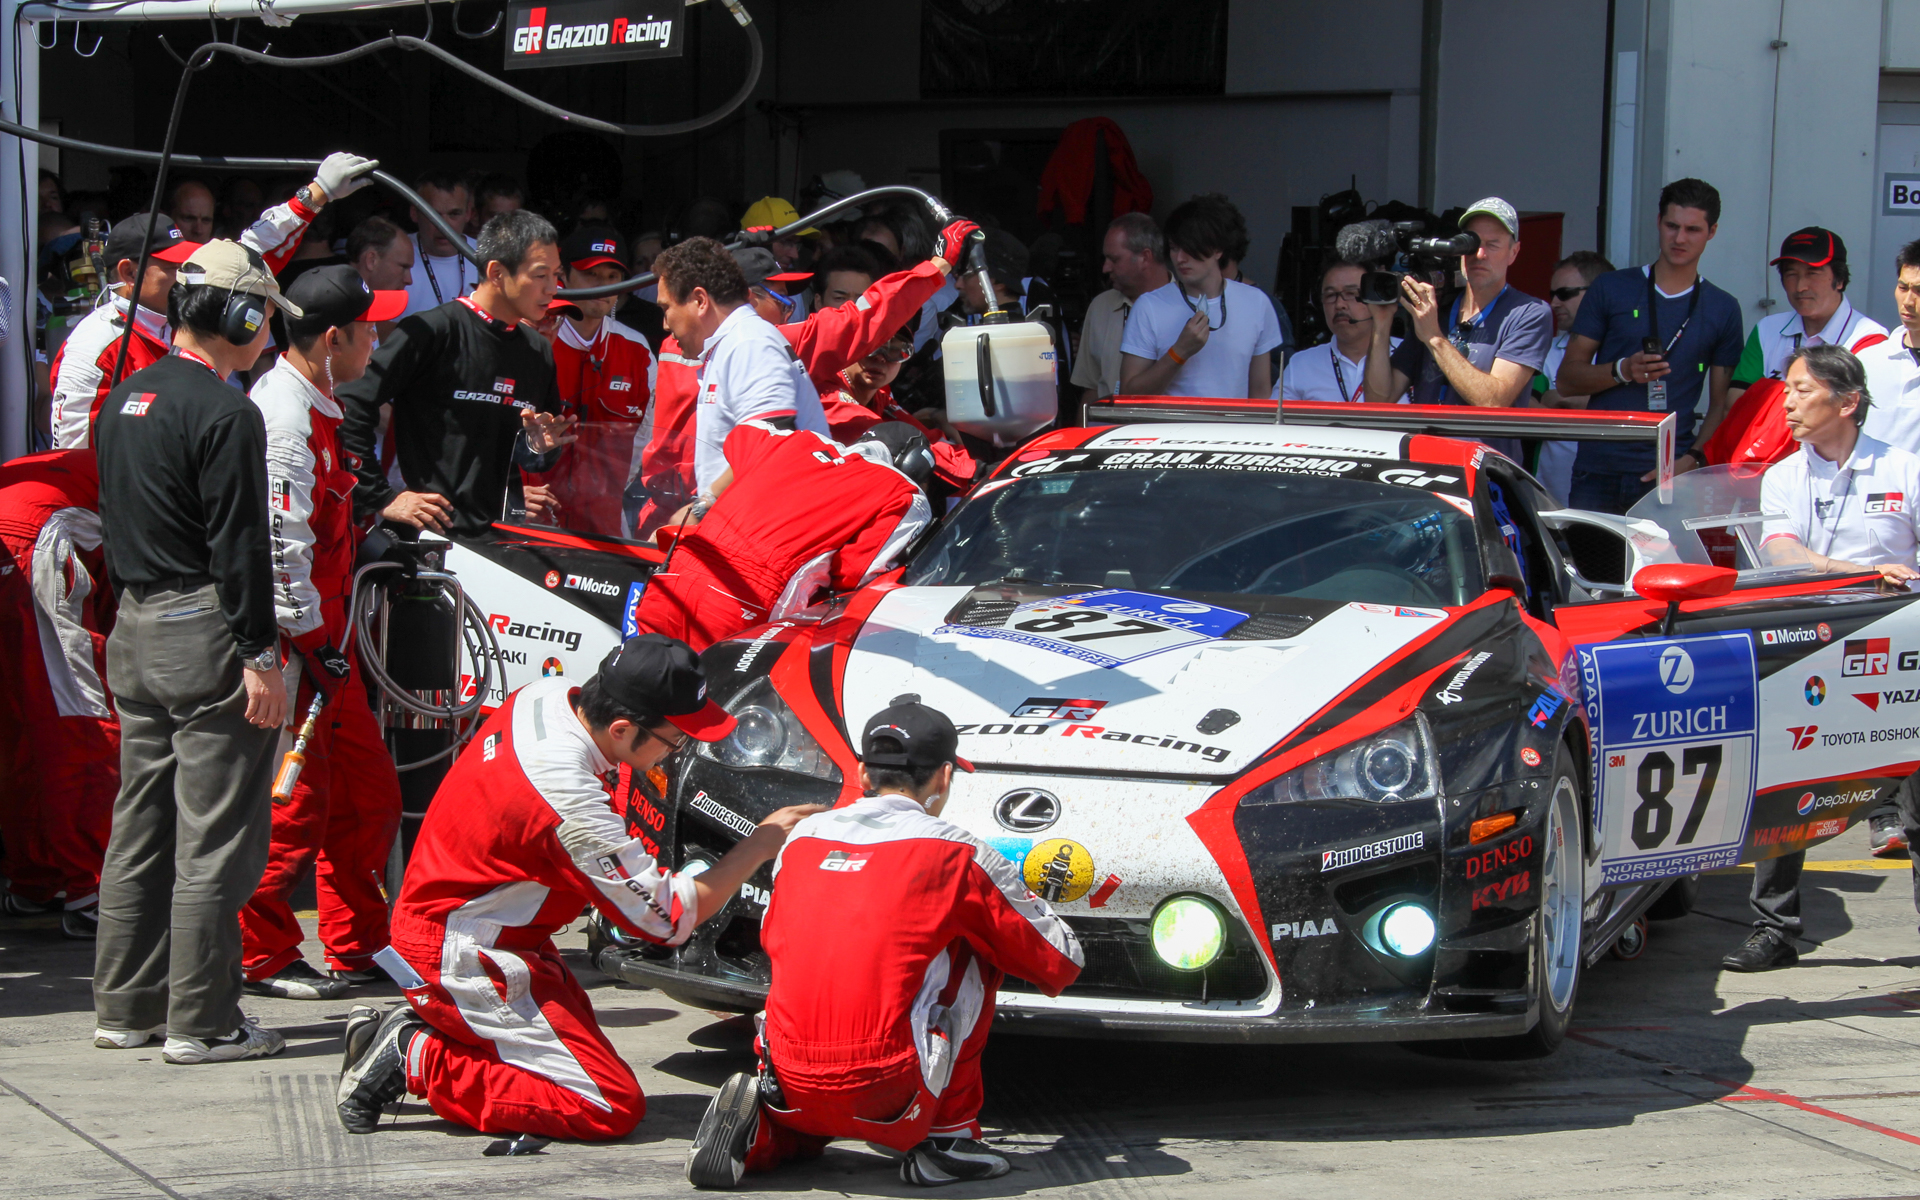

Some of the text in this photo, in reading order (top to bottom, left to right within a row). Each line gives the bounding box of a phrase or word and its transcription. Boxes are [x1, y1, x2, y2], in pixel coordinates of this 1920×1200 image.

[514, 14, 672, 52] GR GAZOO Racing
[591, 242, 616, 253] GR
[454, 390, 501, 404] GAZOO
[493, 383, 514, 393] GR
[607, 380, 632, 392] GR
[122, 401, 150, 415] GR
[1281, 443, 1388, 457] Racing
[1102, 452, 1358, 473] GRAN TURISMO
[1176, 463, 1243, 471] DRIVING
[1246, 465, 1342, 479] SIMULATOR
[272, 478, 284, 509] GR
[1866, 501, 1903, 514] GR
[580, 577, 621, 597] Morizo
[625, 588, 641, 637] ADA
[488, 612, 583, 652] Racing
[1014, 610, 1173, 643] 87
[1778, 628, 1817, 644] Morizo
[1842, 650, 1920, 677] GR G
[1579, 650, 1598, 718] ADAC
[1013, 702, 1091, 721] GR
[1631, 705, 1728, 739] ZURICH
[483, 734, 498, 762] GR
[955, 722, 1231, 763] ZOO Racing
[1821, 731, 1866, 747] TOYOTA
[1608, 755, 1626, 768] 3M
[630, 787, 666, 831] DENSO
[1630, 743, 1724, 851] 87
[1814, 786, 1882, 810] pepsi NEX
[691, 790, 757, 837] BRIDGESTON
[1753, 824, 1804, 847] YAMAHA
[1322, 833, 1424, 871] BRIDGESTONE
[1465, 835, 1532, 879] DENSO
[1607, 848, 1739, 876] NÜRBURGRING
[819, 858, 868, 872] GR
[1604, 857, 1738, 884] NORDSCHLEIFE
[740, 882, 772, 906] PIA
[1471, 870, 1530, 911] KYB
[1273, 916, 1340, 937] PIAA
